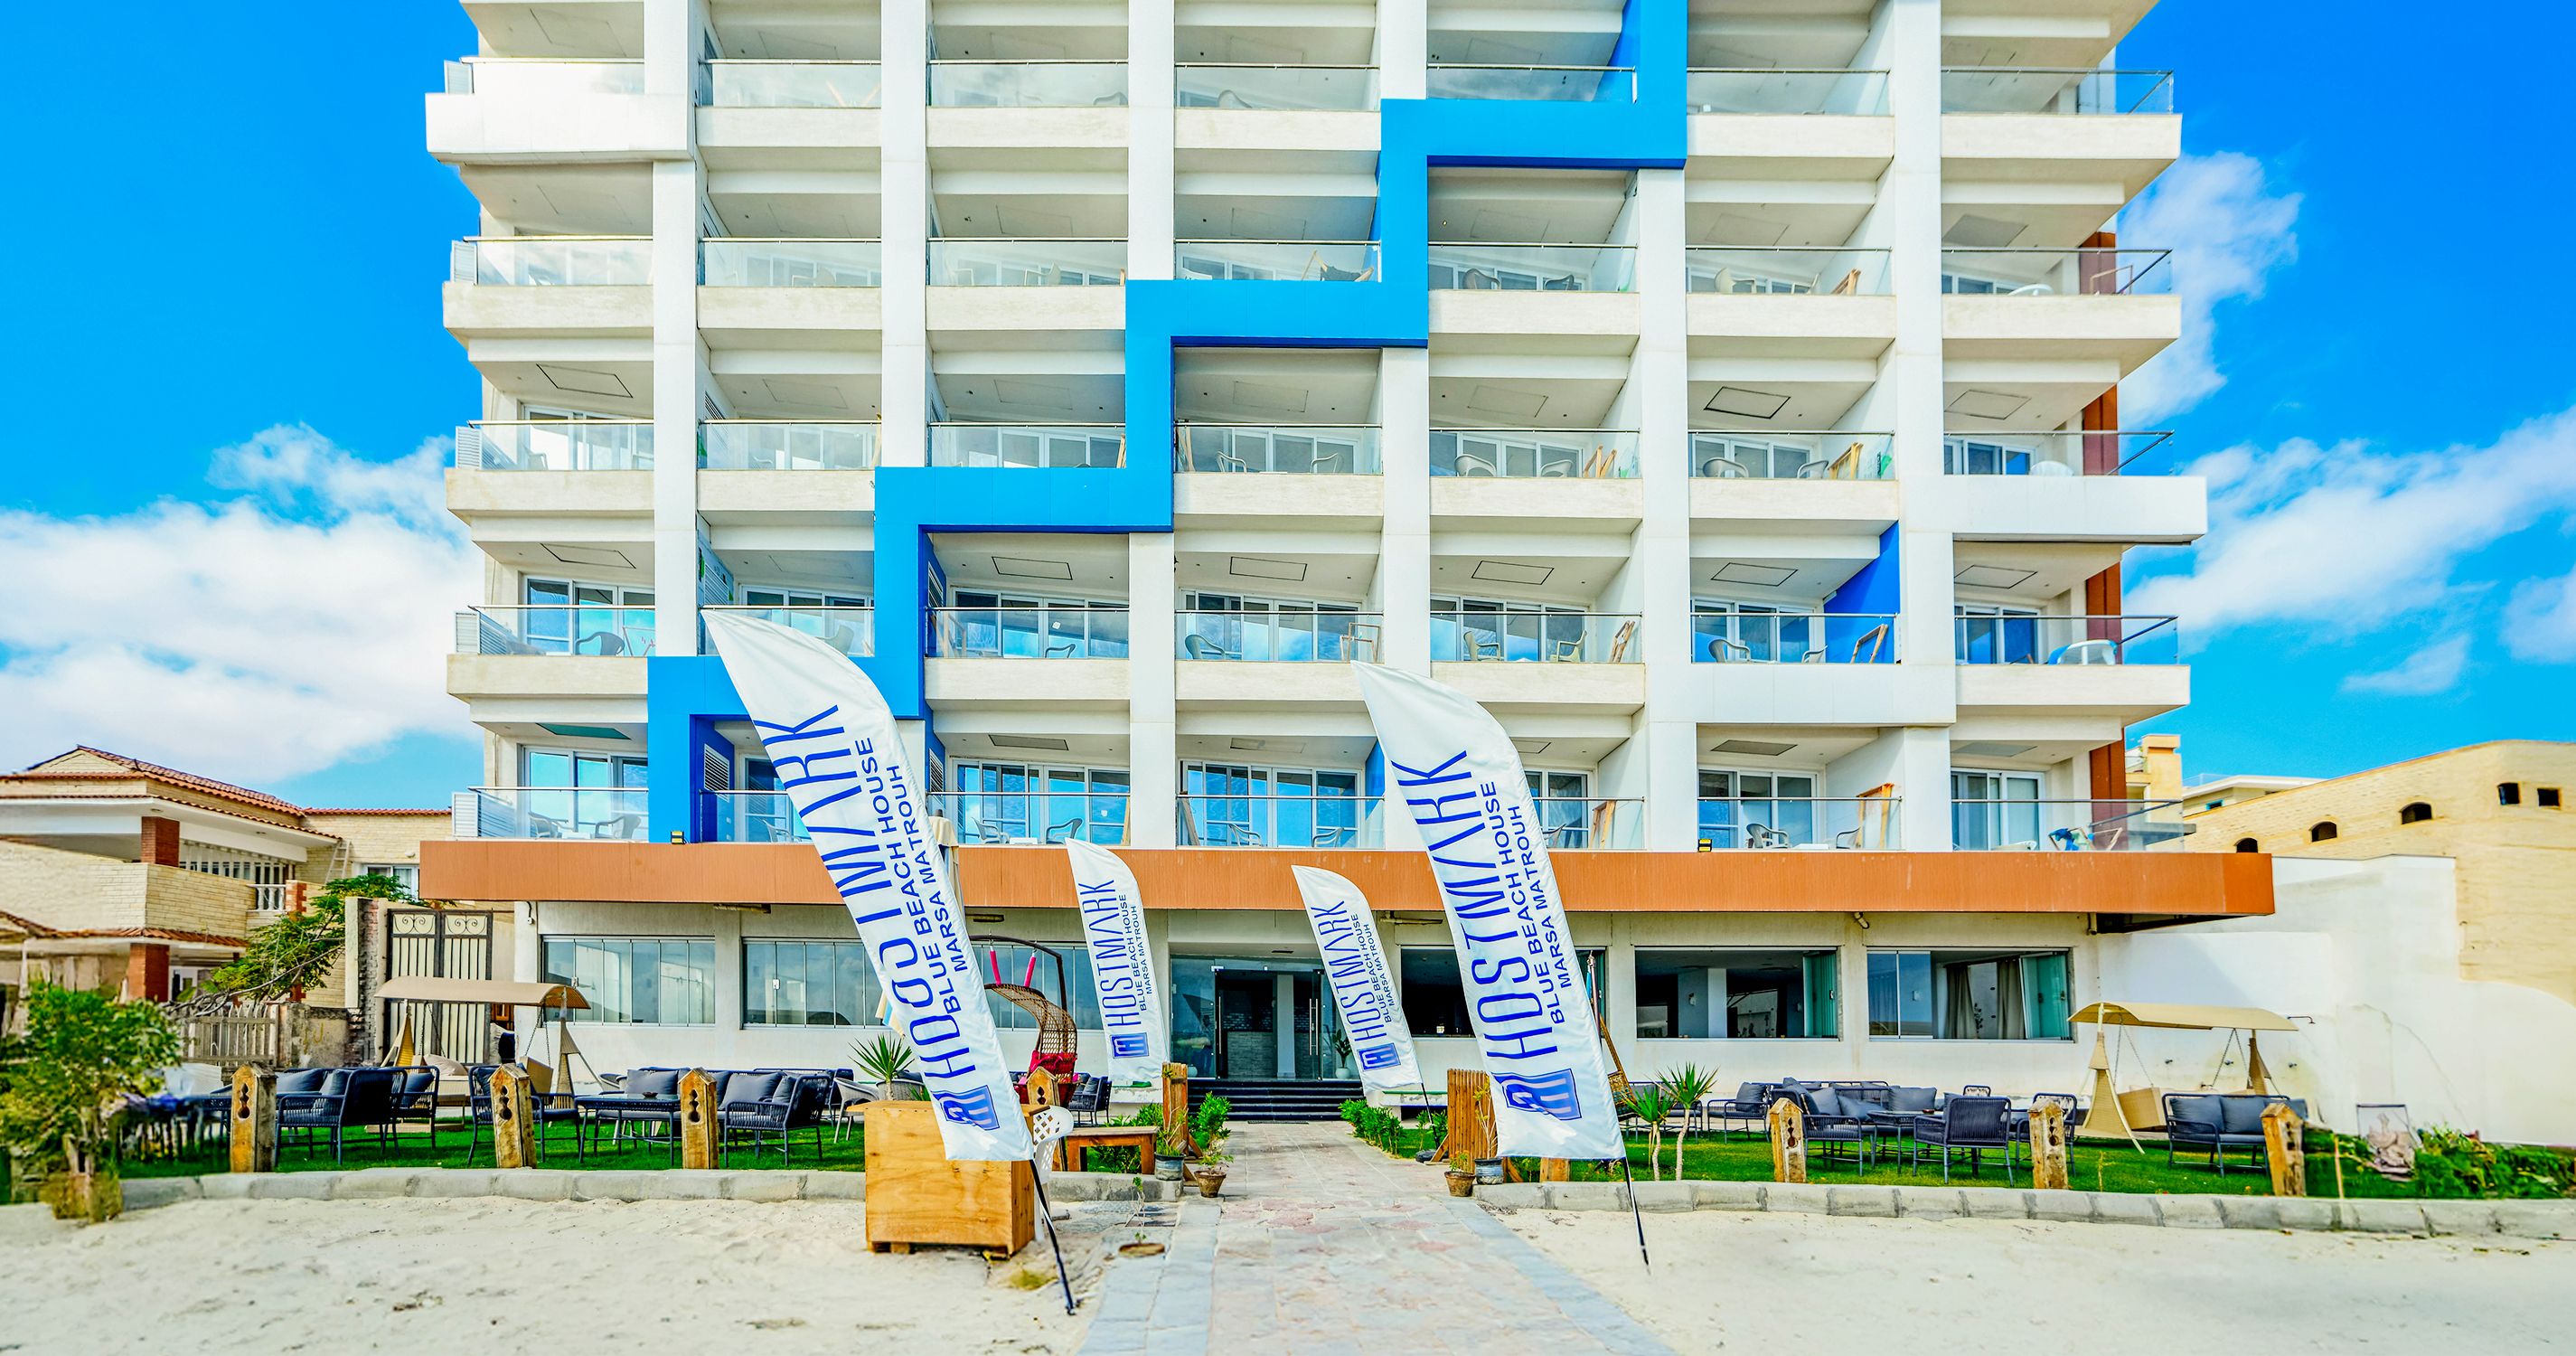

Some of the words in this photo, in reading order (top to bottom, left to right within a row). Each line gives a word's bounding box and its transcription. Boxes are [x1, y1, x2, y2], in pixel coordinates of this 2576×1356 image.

[854, 737, 898, 833] HOUSE
[886, 765, 936, 884] MATROUH
[1480, 781, 1516, 865] HOUSE
[1507, 805, 1548, 910] MATROUH
[886, 842, 933, 936] BEACH
[1118, 894, 1133, 934] HOUSE
[1391, 750, 1559, 1059] HOSTMARK
[1504, 872, 1544, 956] BEACH
[928, 890, 968, 972] MARSA
[1077, 879, 1142, 1028] HOSTMARK
[1126, 937, 1141, 977] BEACH
[1130, 905, 1145, 956] MATROUH
[1350, 913, 1368, 951] HOUSE
[1363, 924, 1383, 971] MATROUH
[1540, 915, 1572, 988] MARSA
[922, 942, 962, 1014] BLUE
[1134, 980, 1147, 1012] BLUE
[1140, 958, 1152, 994] MARSA
[1311, 900, 1388, 1042] HOSTMARK
[1363, 953, 1381, 992] BEACH
[1379, 973, 1395, 1006] MARSA
[1533, 961, 1565, 1024] BLUE
[1376, 993, 1392, 1023] BLUE
